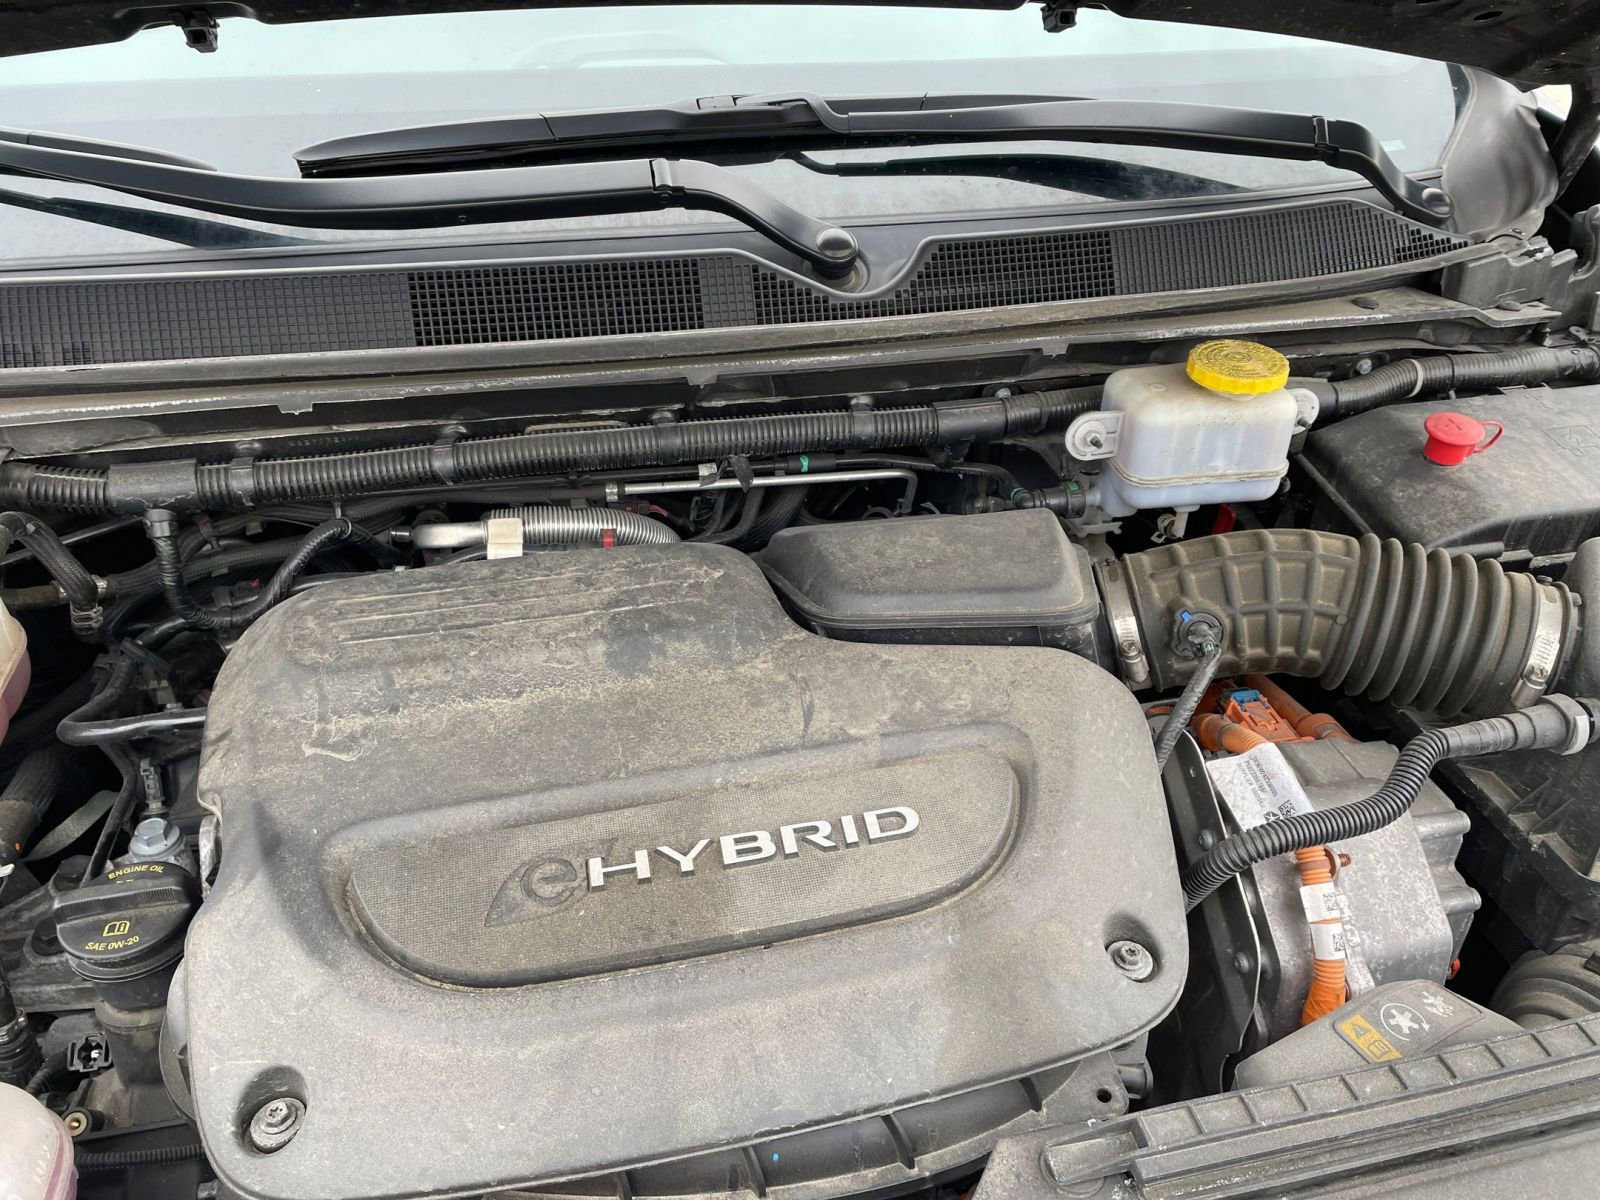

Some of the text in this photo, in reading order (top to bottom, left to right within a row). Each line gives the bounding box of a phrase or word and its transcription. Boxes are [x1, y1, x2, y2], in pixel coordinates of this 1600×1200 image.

[108, 865, 164, 879] ENGINE OIL
[85, 936, 139, 950] SAE 0W-20
